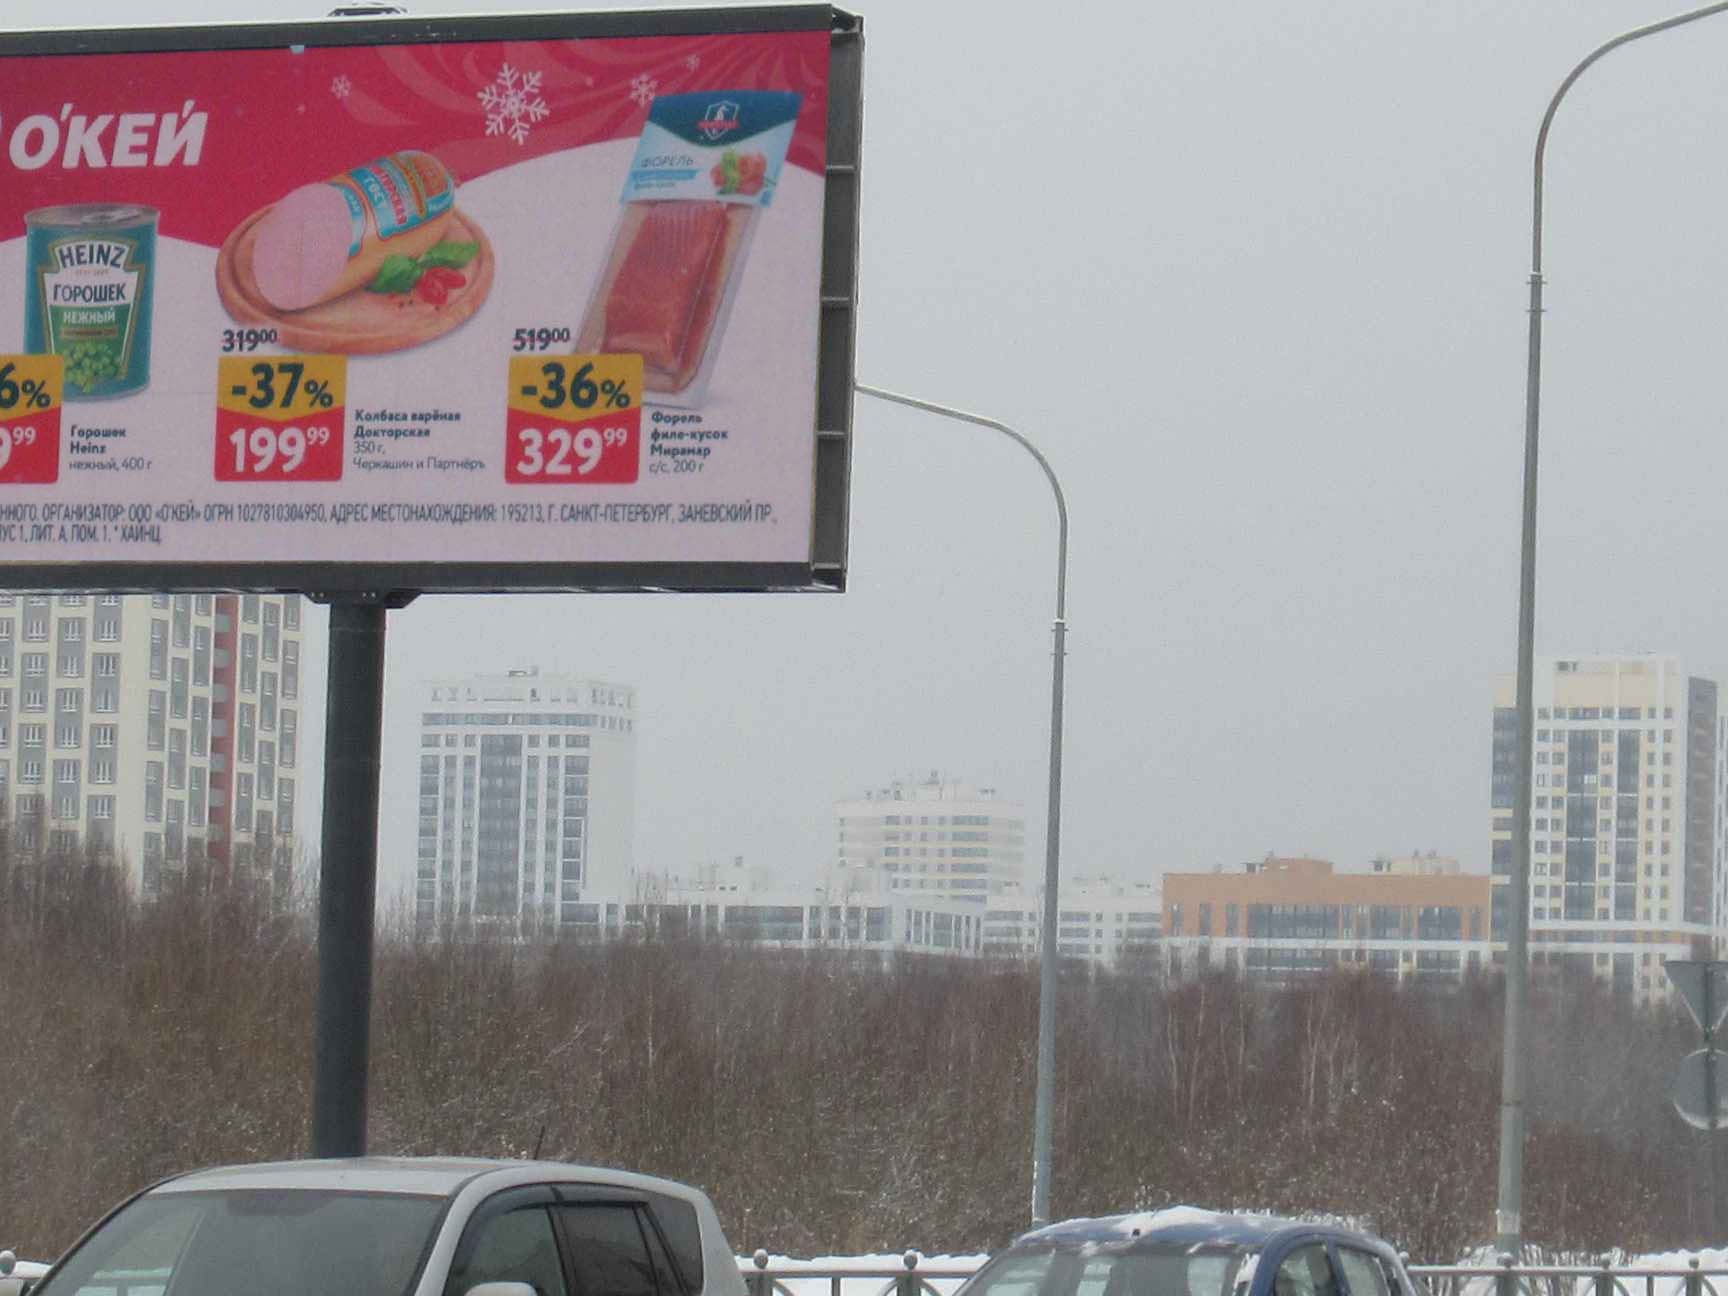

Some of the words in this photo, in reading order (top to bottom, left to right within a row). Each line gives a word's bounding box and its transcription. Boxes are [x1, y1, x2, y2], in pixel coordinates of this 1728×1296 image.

[58, 242, 125, 268] HEINZ
[53, 283, 127, 303] ГОРОШЕК
[63, 306, 116, 325] НЕЖНЫЙ
[231, 363, 334, 409] -37%
[520, 362, 632, 409] -36%
[354, 409, 408, 422] Колбаса
[411, 409, 461, 424] варёная
[651, 411, 703, 425] Форель
[71, 424, 127, 440] Горошек
[354, 425, 430, 440] Докторская
[650, 427, 729, 443] филе-кусок
[70, 441, 108, 455] Heinz
[354, 440, 376, 454] 350
[122, 456, 145, 470] 400
[353, 456, 414, 471] Черкашин
[416, 460, 424, 470] и
[673, 459, 697, 473] 200
[128, 503, 153, 522] ООО
[204, 503, 234, 522] ОГРН
[330, 503, 369, 524] АДРЕС
[678, 499, 752, 522] ЗАНЕВСКИЙ
